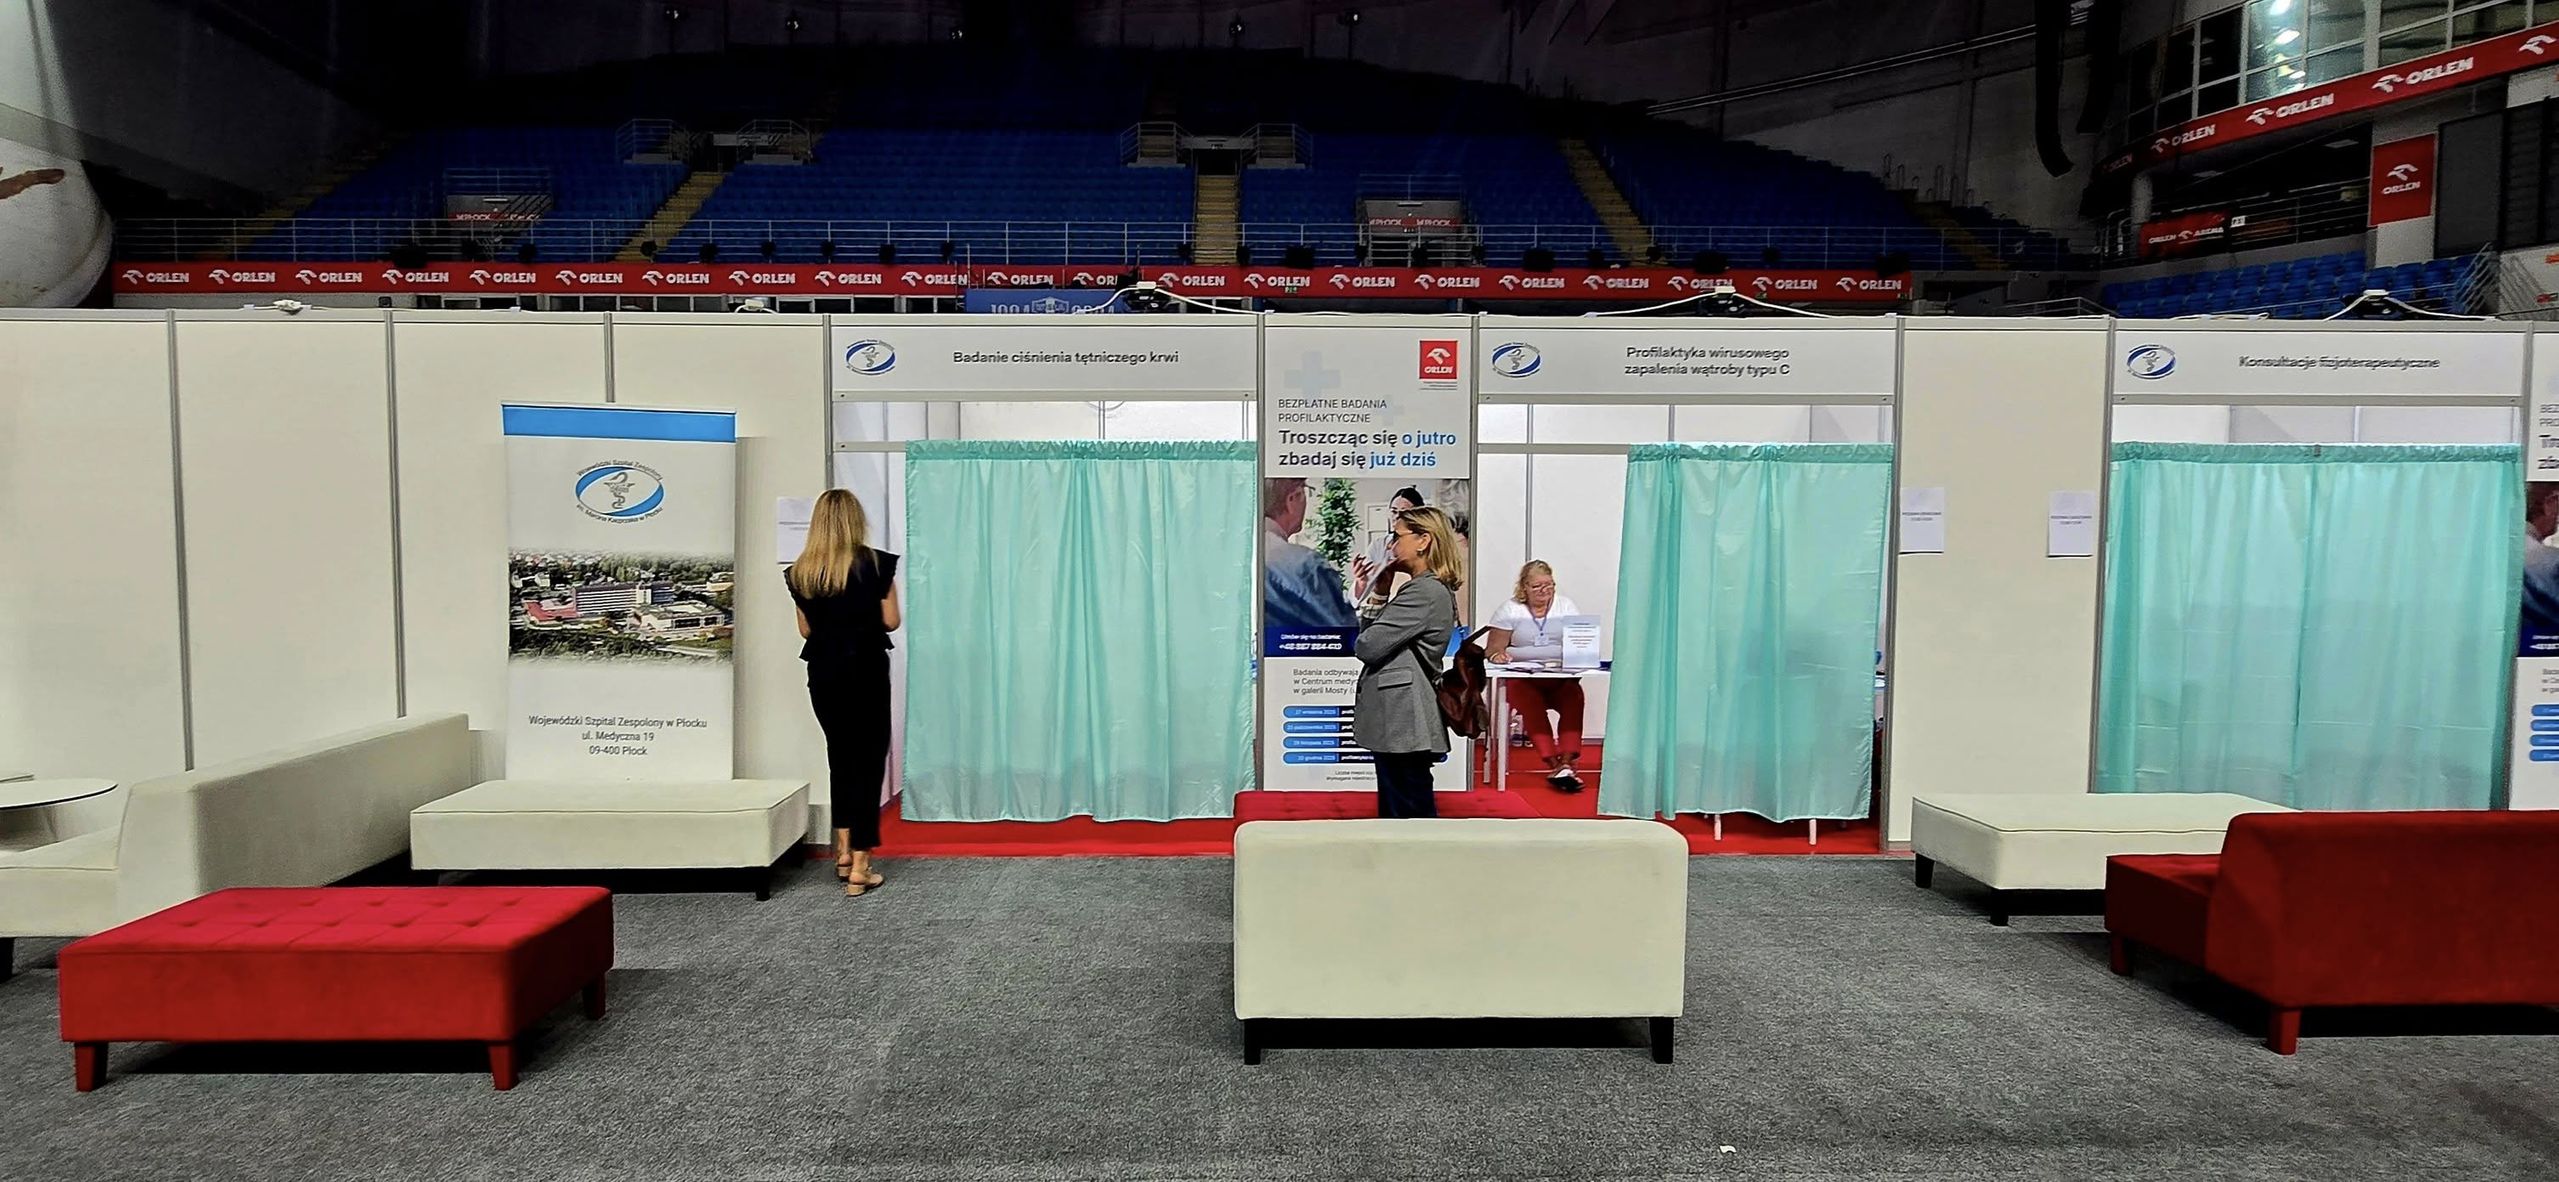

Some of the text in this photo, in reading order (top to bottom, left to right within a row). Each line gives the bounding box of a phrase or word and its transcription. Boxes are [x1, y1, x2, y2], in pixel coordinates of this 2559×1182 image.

[2405, 57, 2474, 85] ORLEN
[2276, 93, 2334, 118] ORLEN
[2171, 124, 2215, 147] ORLEN
[2381, 181, 2421, 195] ORLEN
[146, 272, 189, 284] ORLEN
[232, 272, 276, 284] ORLEN
[318, 272, 362, 284] ORLEN
[405, 272, 449, 284] ORLEN
[492, 272, 536, 284] ORLEN
[579, 272, 623, 285] ORLEN
[666, 273, 709, 285] ORLEN
[752, 273, 796, 285] ORLEN
[838, 273, 882, 286] ORLEN
[924, 273, 968, 286] ORLEN
[1010, 274, 1053, 285] ORLEN
[1182, 275, 1225, 287] ORLEN
[1267, 276, 1310, 287] ORLEN
[1352, 276, 1396, 288] ORLEN
[1437, 276, 1480, 289] ORLEN
[1522, 277, 1565, 289] ORLEN
[1606, 277, 1649, 289] ORLEN
[1774, 278, 1818, 291] ORLEN
[1859, 279, 1902, 292] ORLEN
[953, 350, 1179, 366] Badanie ciśnienia tętniczego krwi
[1626, 346, 1790, 361] Profilaktyka wirusowego
[2239, 355, 2440, 371] Konsultacje fizjoterapeutyczne
[1424, 366, 1453, 374] ORLEN
[1625, 363, 1790, 378] zapalenia wątroby typu C
[1278, 399, 1387, 409] BEZPŁATNE BADANIA
[1278, 413, 1371, 423] PROFILAKTYCZNE
[1278, 429, 1456, 448] Troszcząc się o jutro
[1278, 451, 1436, 469] zbadaj się już dziś
[1293, 668, 1322, 676] Badania
[1302, 687, 1323, 695] galerii
[1325, 687, 1347, 695] Mosty
[528, 715, 708, 730] Wojewódzki Szpital Zespolony w Płocku
[582, 731, 655, 743] ul. Medyczna 19
[589, 745, 648, 756] 09-400 Płock
